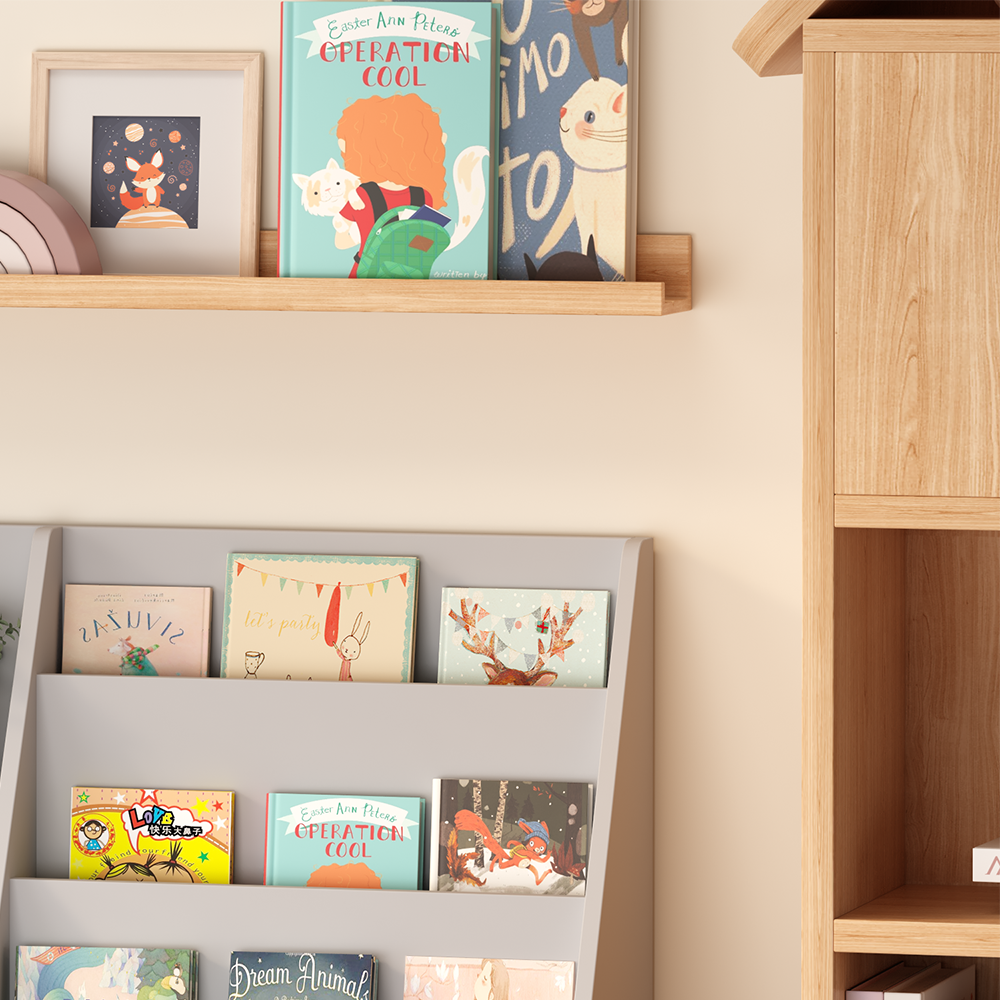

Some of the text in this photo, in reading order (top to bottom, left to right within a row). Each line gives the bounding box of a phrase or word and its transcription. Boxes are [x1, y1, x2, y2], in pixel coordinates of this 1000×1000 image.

[327, 17, 372, 39] Easter
[320, 41, 470, 63] OPERATION
[362, 66, 426, 87] COOL
[474, 270, 487, 280] by
[279, 612, 322, 641] party
[300, 806, 333, 822] Easter
[149, 825, 203, 837] 快乐大鼻子
[295, 823, 404, 841] OPERATION
[325, 842, 372, 858] COOL
